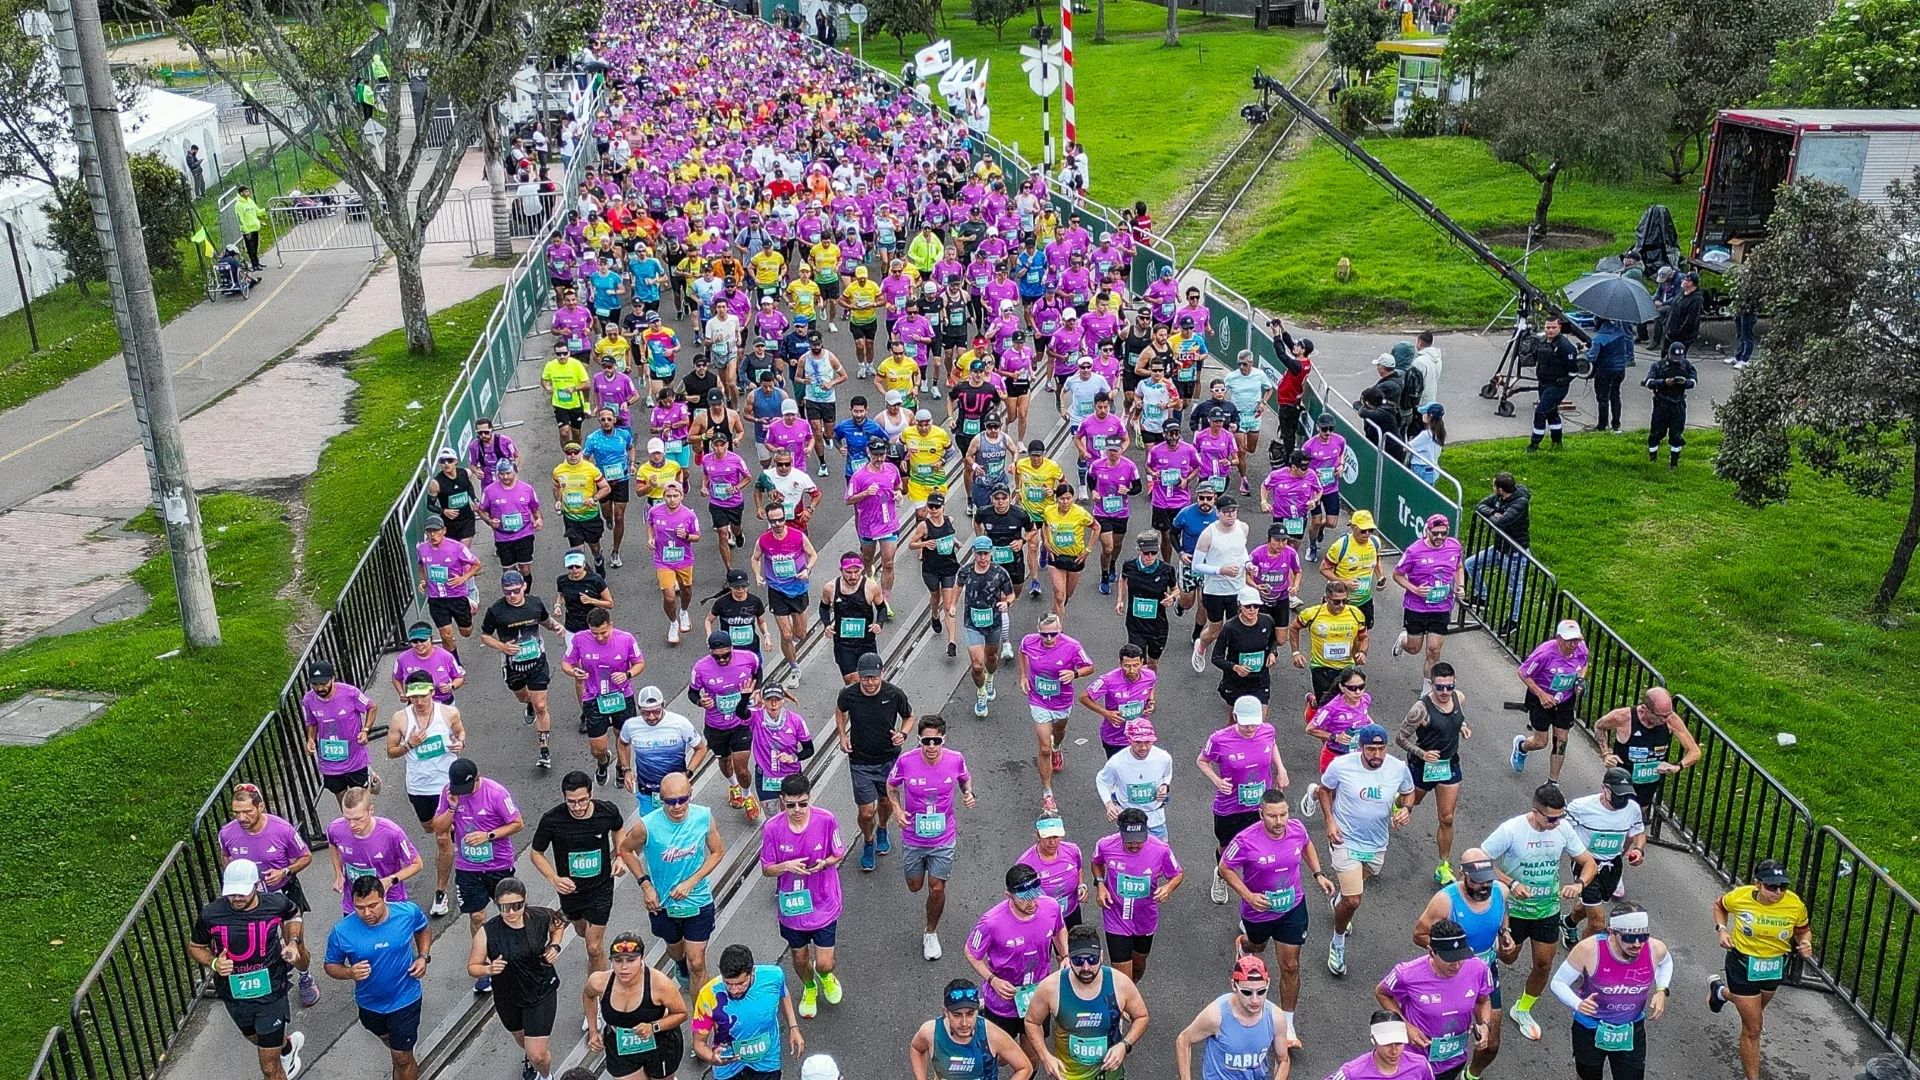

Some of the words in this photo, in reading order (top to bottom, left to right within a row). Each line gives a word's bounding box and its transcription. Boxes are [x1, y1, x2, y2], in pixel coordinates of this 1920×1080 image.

[727, 616, 754, 624] ether
[324, 745, 345, 754] 2123
[1131, 788, 1152, 798] 3412
[919, 820, 941, 830] 3516
[1594, 838, 1618, 849] 3610
[464, 846, 489, 856] 2033
[572, 857, 598, 869] 4608
[1122, 881, 1145, 892] 1973
[785, 897, 805, 908] 446
[1752, 960, 1779, 972] 4638
[239, 979, 261, 991] 279
[1602, 983, 1646, 995] ether
[1606, 1003, 1635, 1011] DIEGO
[1090, 1012, 1103, 1020] COL
[620, 1035, 650, 1047] 275
[1602, 1030, 1628, 1042] 5731
[738, 1042, 766, 1056] 4410
[1072, 1044, 1103, 1057] 3864
[1438, 1042, 1459, 1053] 525
